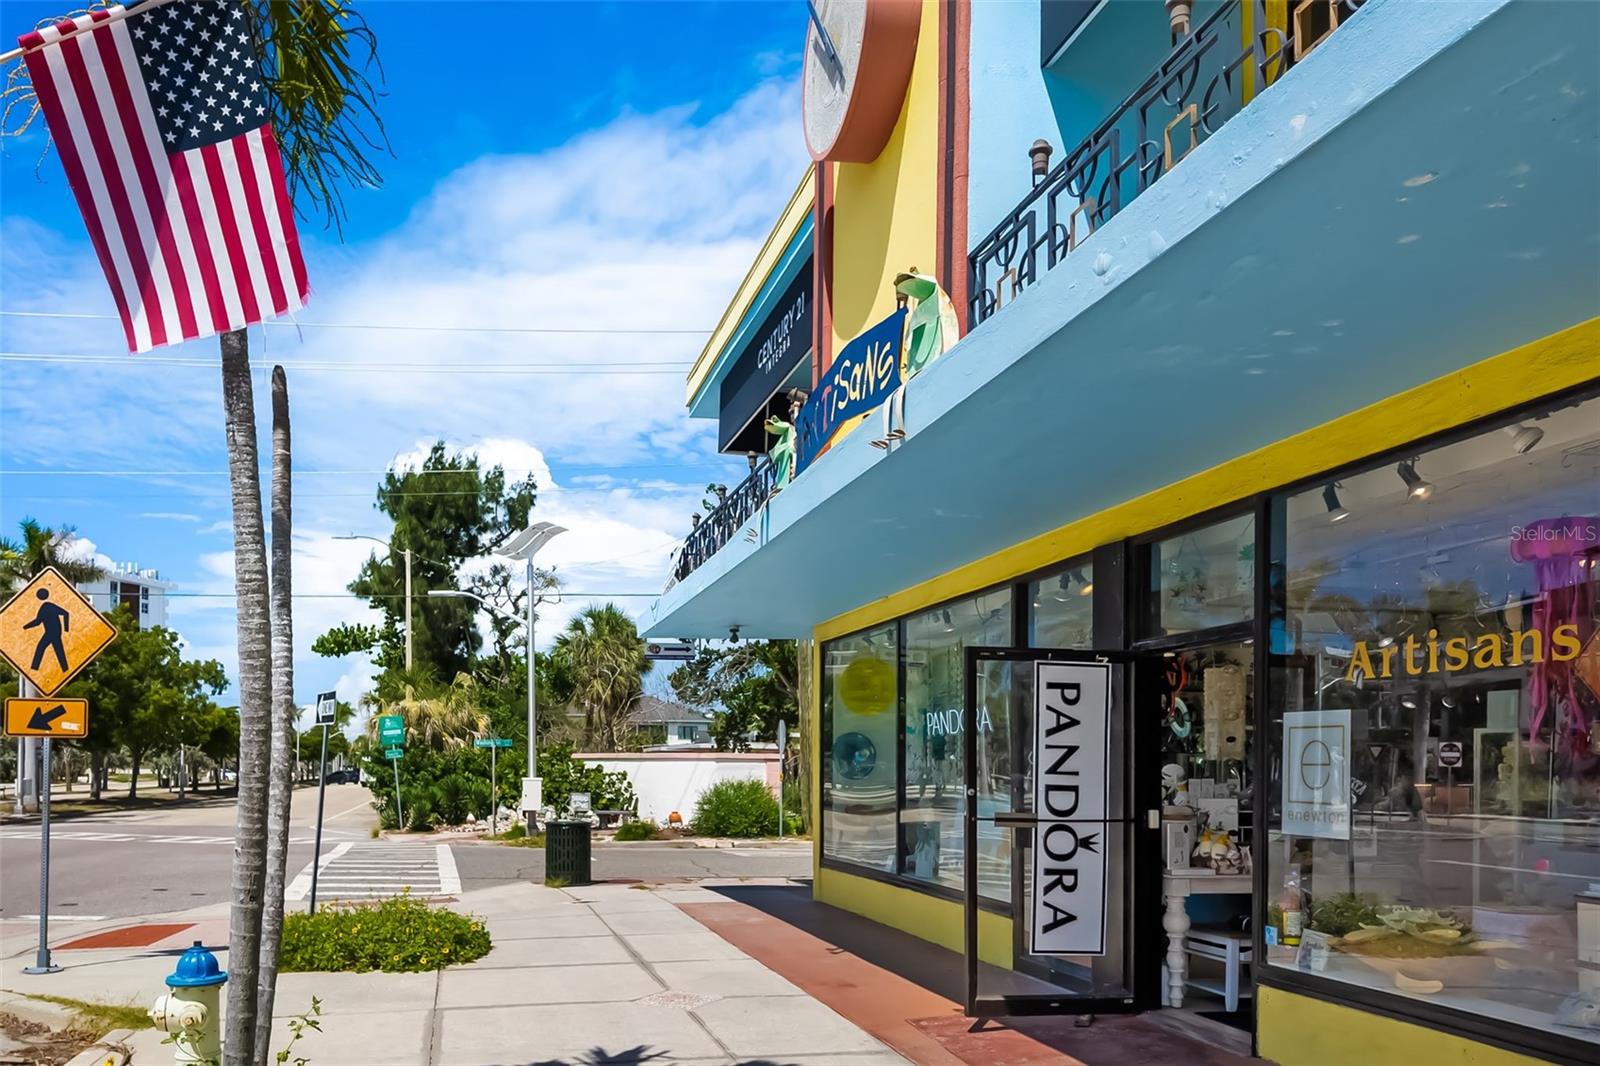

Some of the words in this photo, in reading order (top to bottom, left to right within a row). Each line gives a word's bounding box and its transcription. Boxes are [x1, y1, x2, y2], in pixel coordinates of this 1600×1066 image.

[757, 304, 796, 369] CENTURY
[796, 291, 805, 321] 21
[765, 335, 791, 375] INTEGRA
[1344, 623, 1582, 681] Artisans
[1041, 681, 1081, 935] PANDORA
